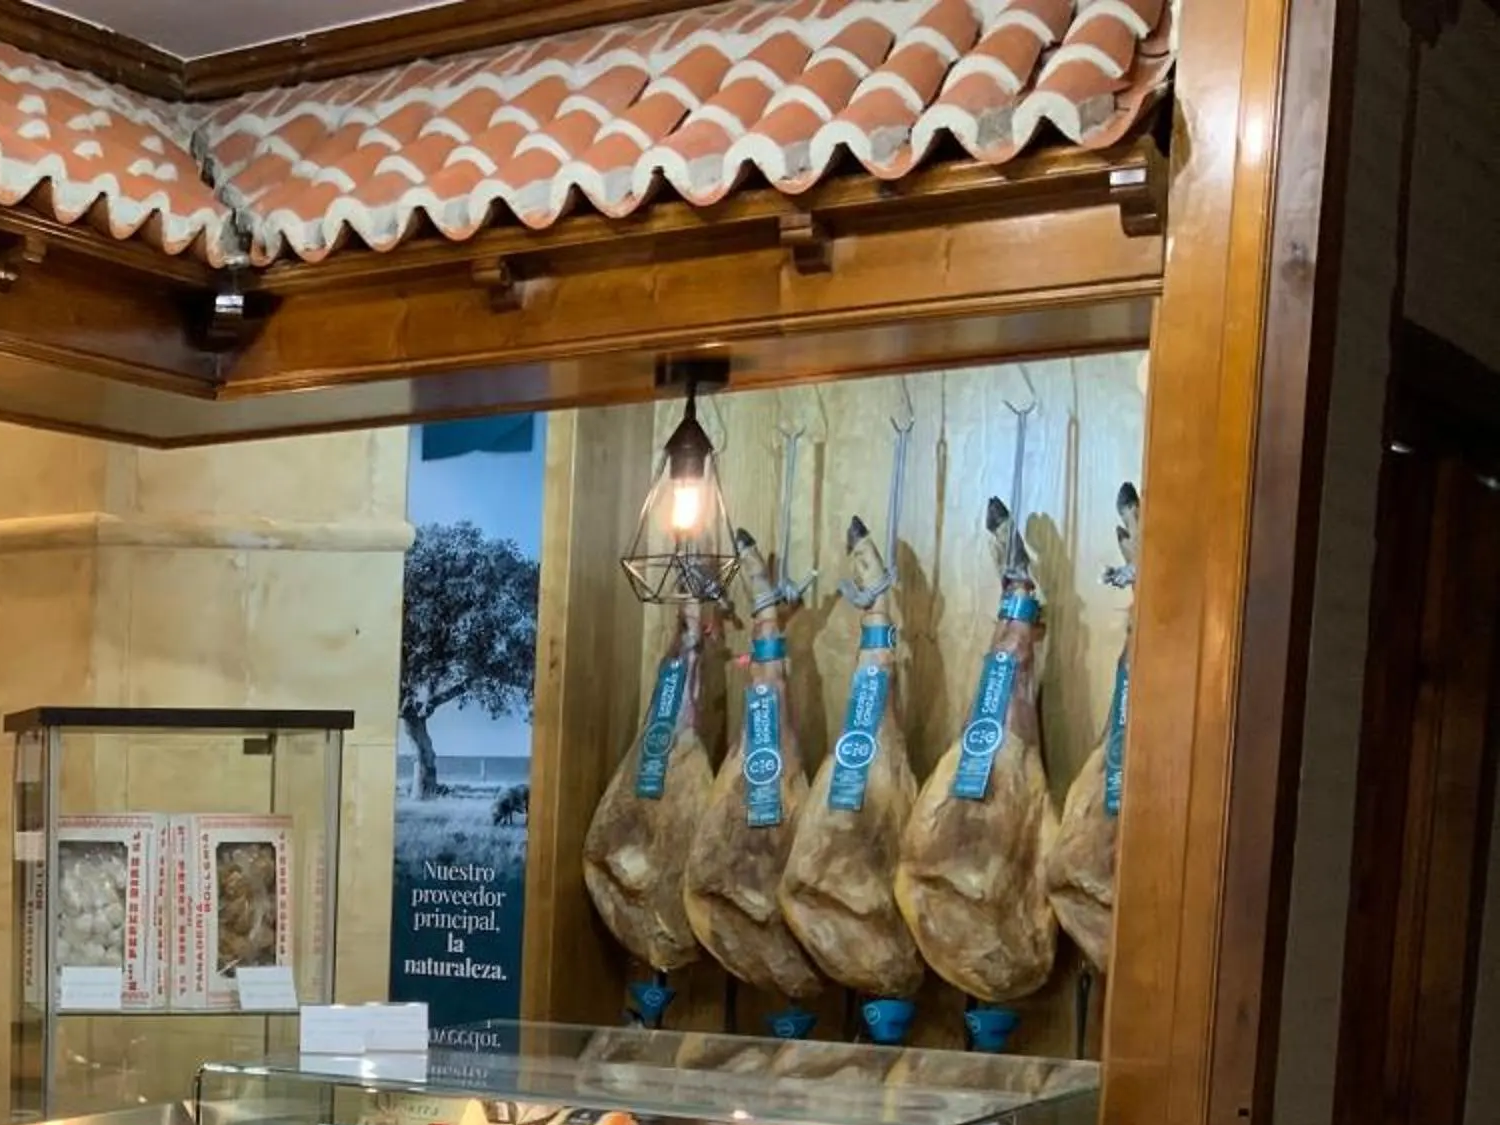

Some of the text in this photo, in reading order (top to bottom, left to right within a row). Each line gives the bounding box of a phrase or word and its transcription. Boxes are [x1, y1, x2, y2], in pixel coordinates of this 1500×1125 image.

[423, 860, 496, 882] Nuestro
[411, 885, 507, 907] proveedor
[447, 931, 465, 953] la
[404, 957, 507, 981] naturaleza.
